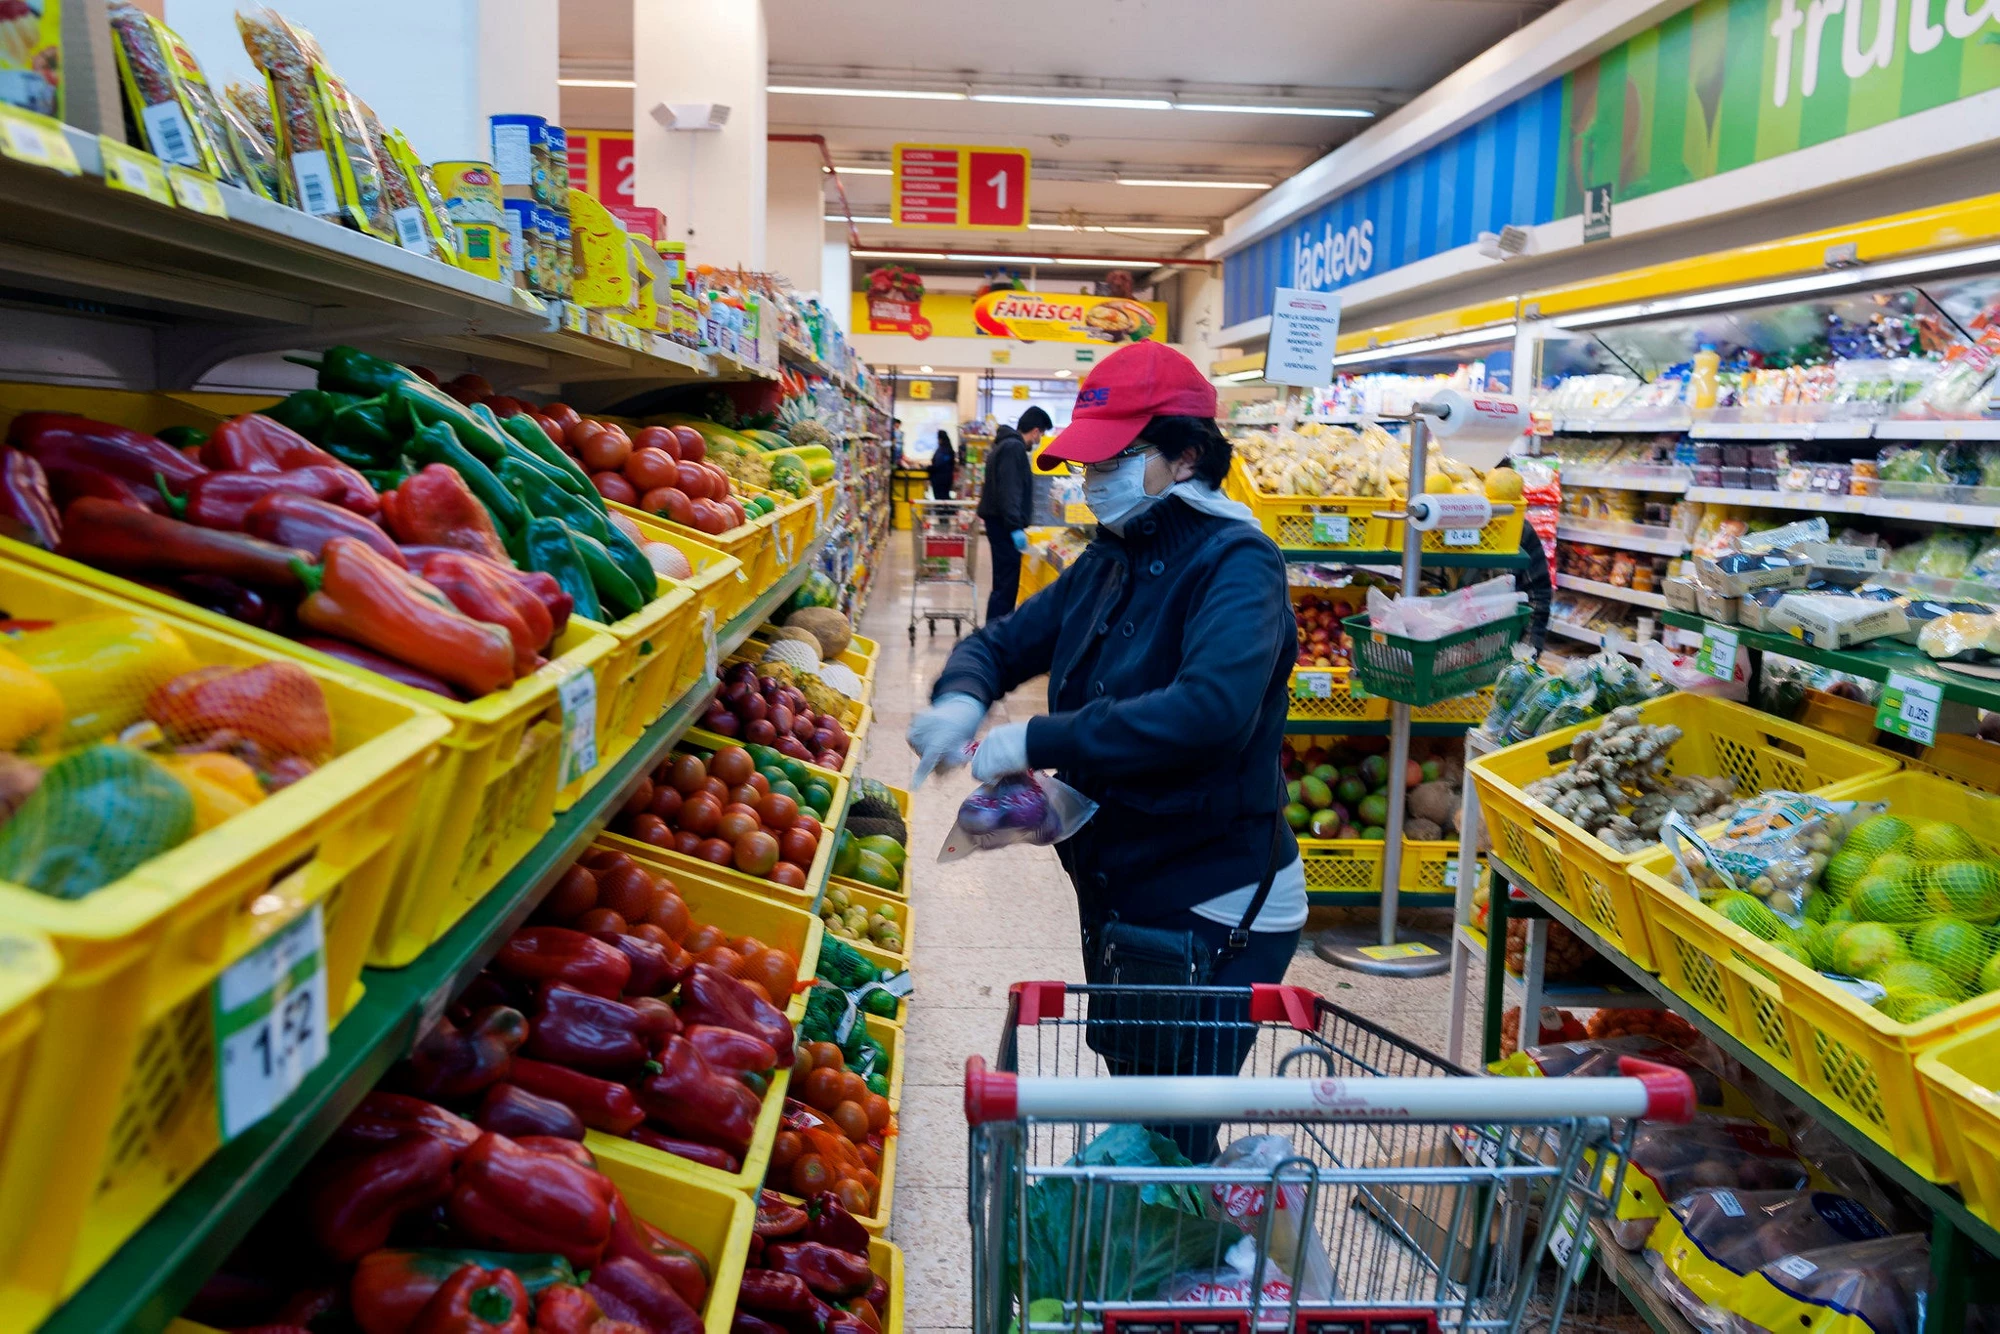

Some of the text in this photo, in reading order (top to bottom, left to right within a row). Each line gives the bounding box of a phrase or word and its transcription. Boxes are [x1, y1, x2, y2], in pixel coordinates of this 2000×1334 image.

[986, 169, 1007, 209] 1
[1294, 219, 1374, 291] lácteos
[993, 301, 1083, 322] FANESCA
[1244, 1106, 1411, 1118] SANTA MARIA
